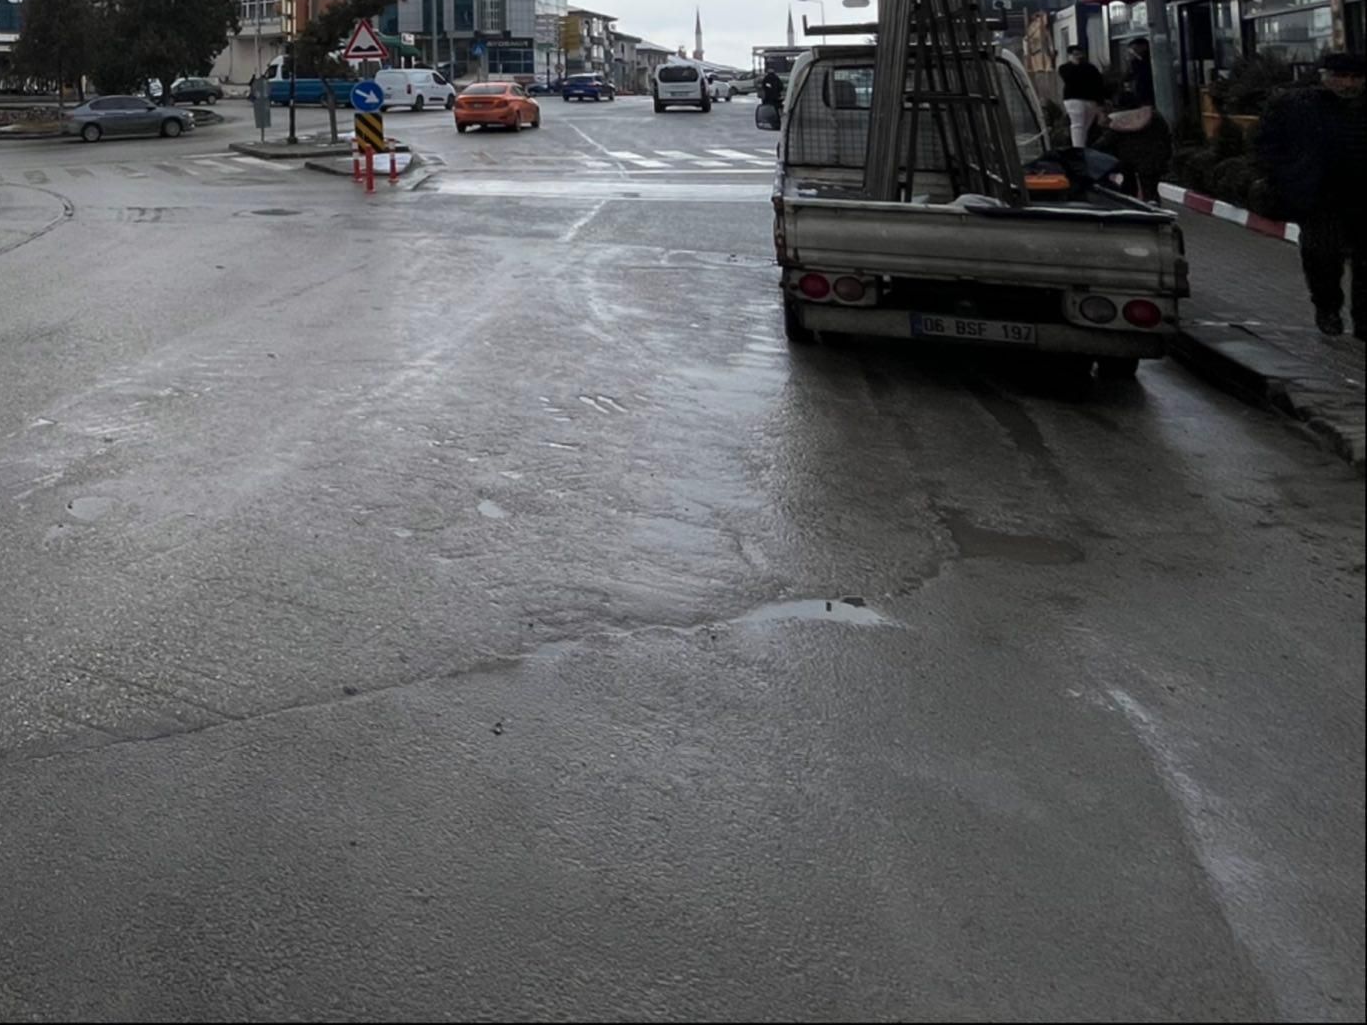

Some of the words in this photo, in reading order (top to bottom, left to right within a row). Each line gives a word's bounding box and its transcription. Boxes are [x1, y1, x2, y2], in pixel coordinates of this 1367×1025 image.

[924, 317, 945, 333] 06
[955, 320, 987, 336] BSF
[1001, 324, 1033, 341] 197
